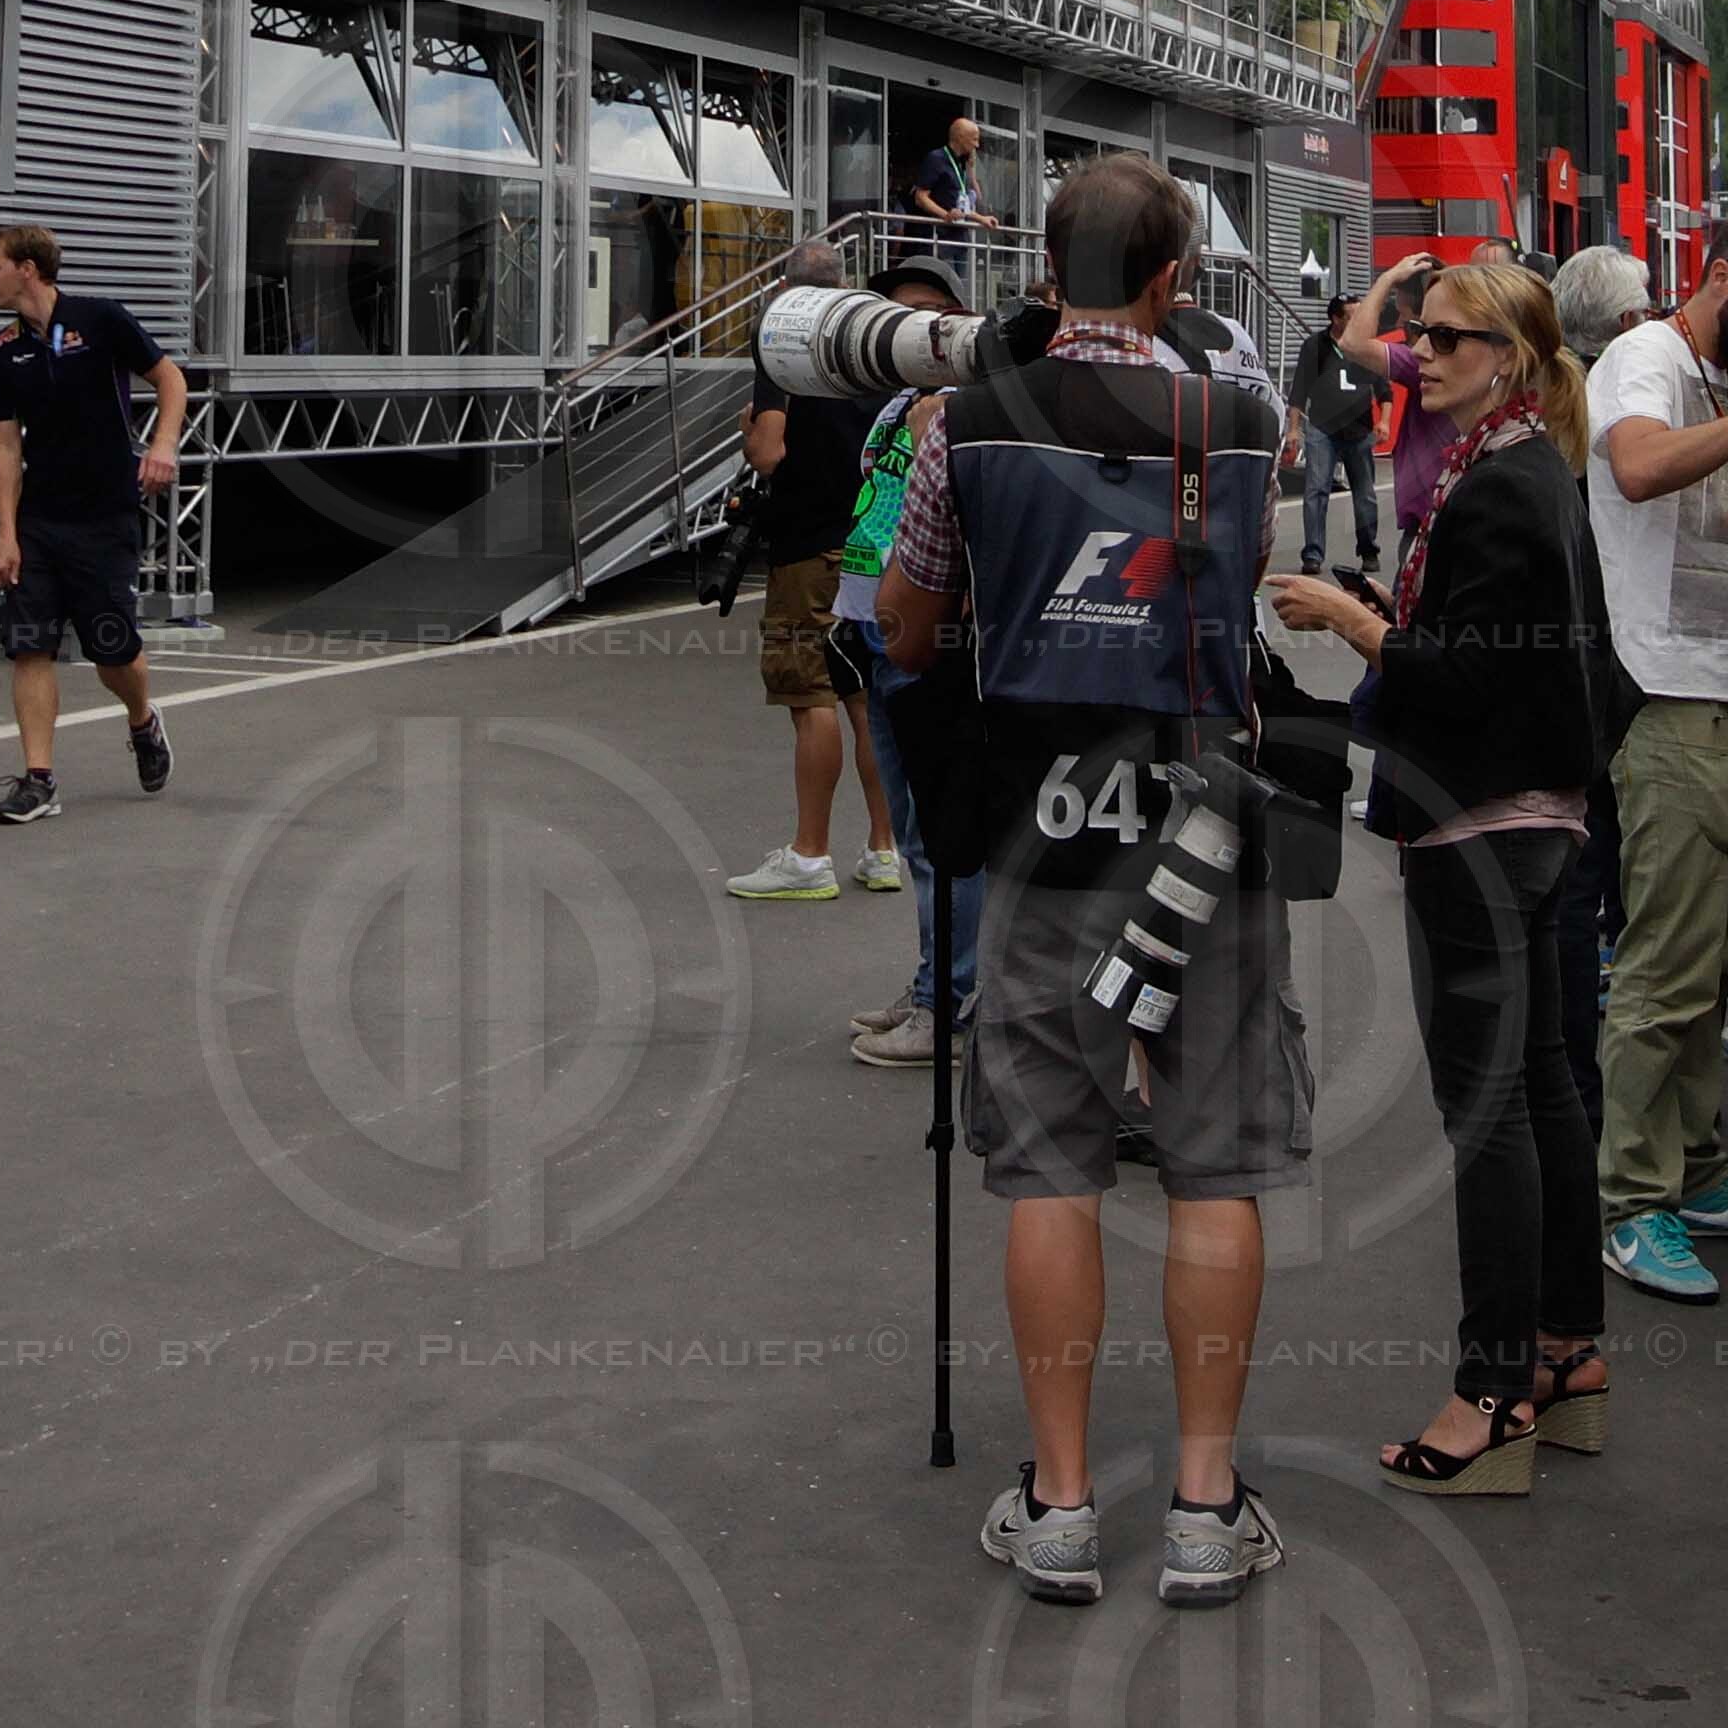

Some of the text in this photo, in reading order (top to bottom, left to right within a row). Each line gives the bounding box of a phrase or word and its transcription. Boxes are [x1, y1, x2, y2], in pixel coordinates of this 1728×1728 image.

[1182, 472, 1200, 521] EOS
[1040, 612, 1073, 622] WORLD
[1044, 597, 1153, 618] FIA Formula 1
